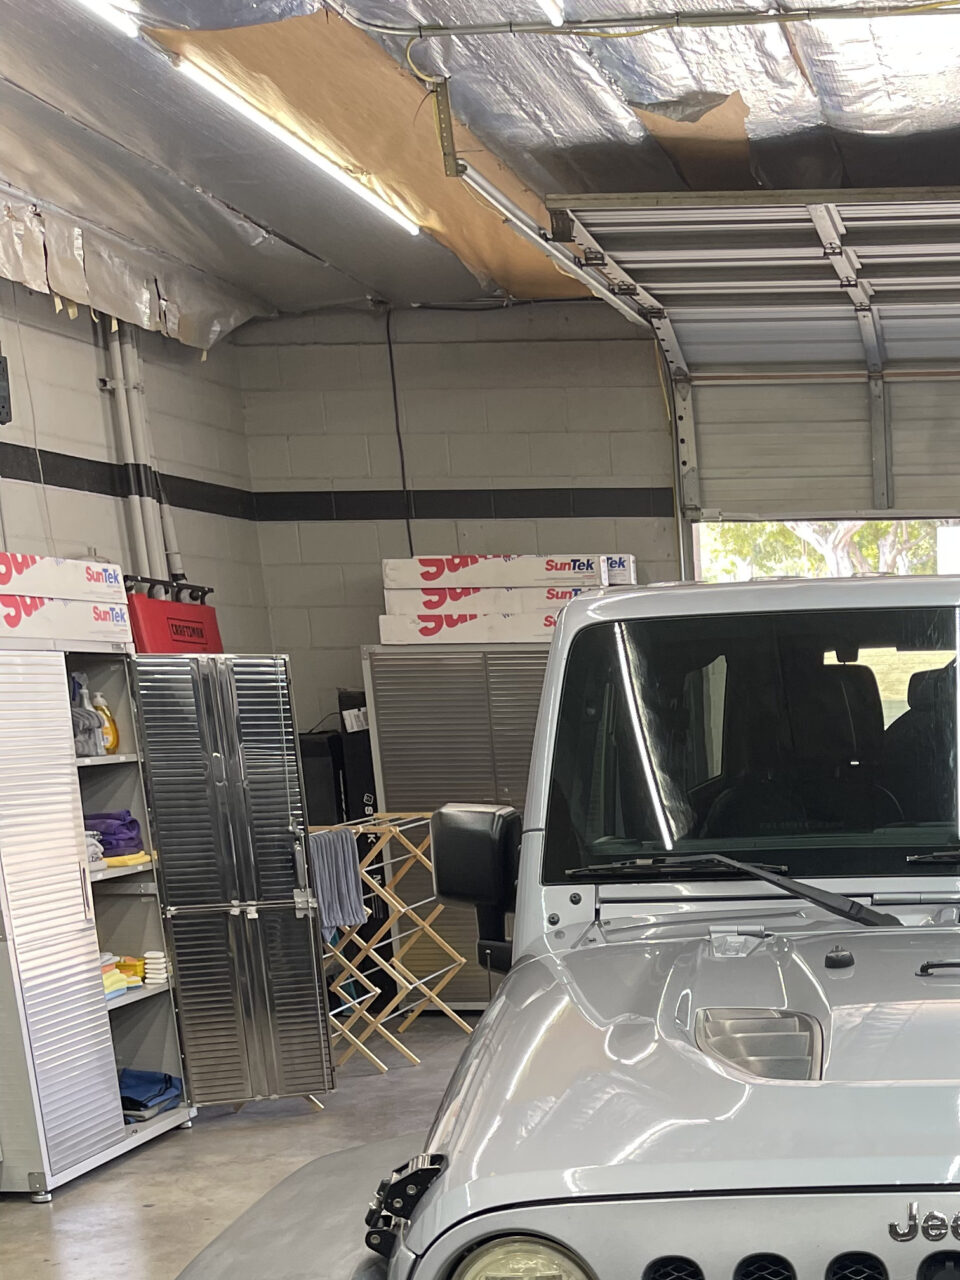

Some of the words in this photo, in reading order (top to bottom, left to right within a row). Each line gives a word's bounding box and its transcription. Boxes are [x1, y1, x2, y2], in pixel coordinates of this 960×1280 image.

[545, 558, 595, 572] SunTek
[86, 566, 120, 584] SunTek
[546, 588, 582, 600] SunT
[93, 606, 127, 623] SunTek
[171, 623, 204, 638] CRAFTSMAN
